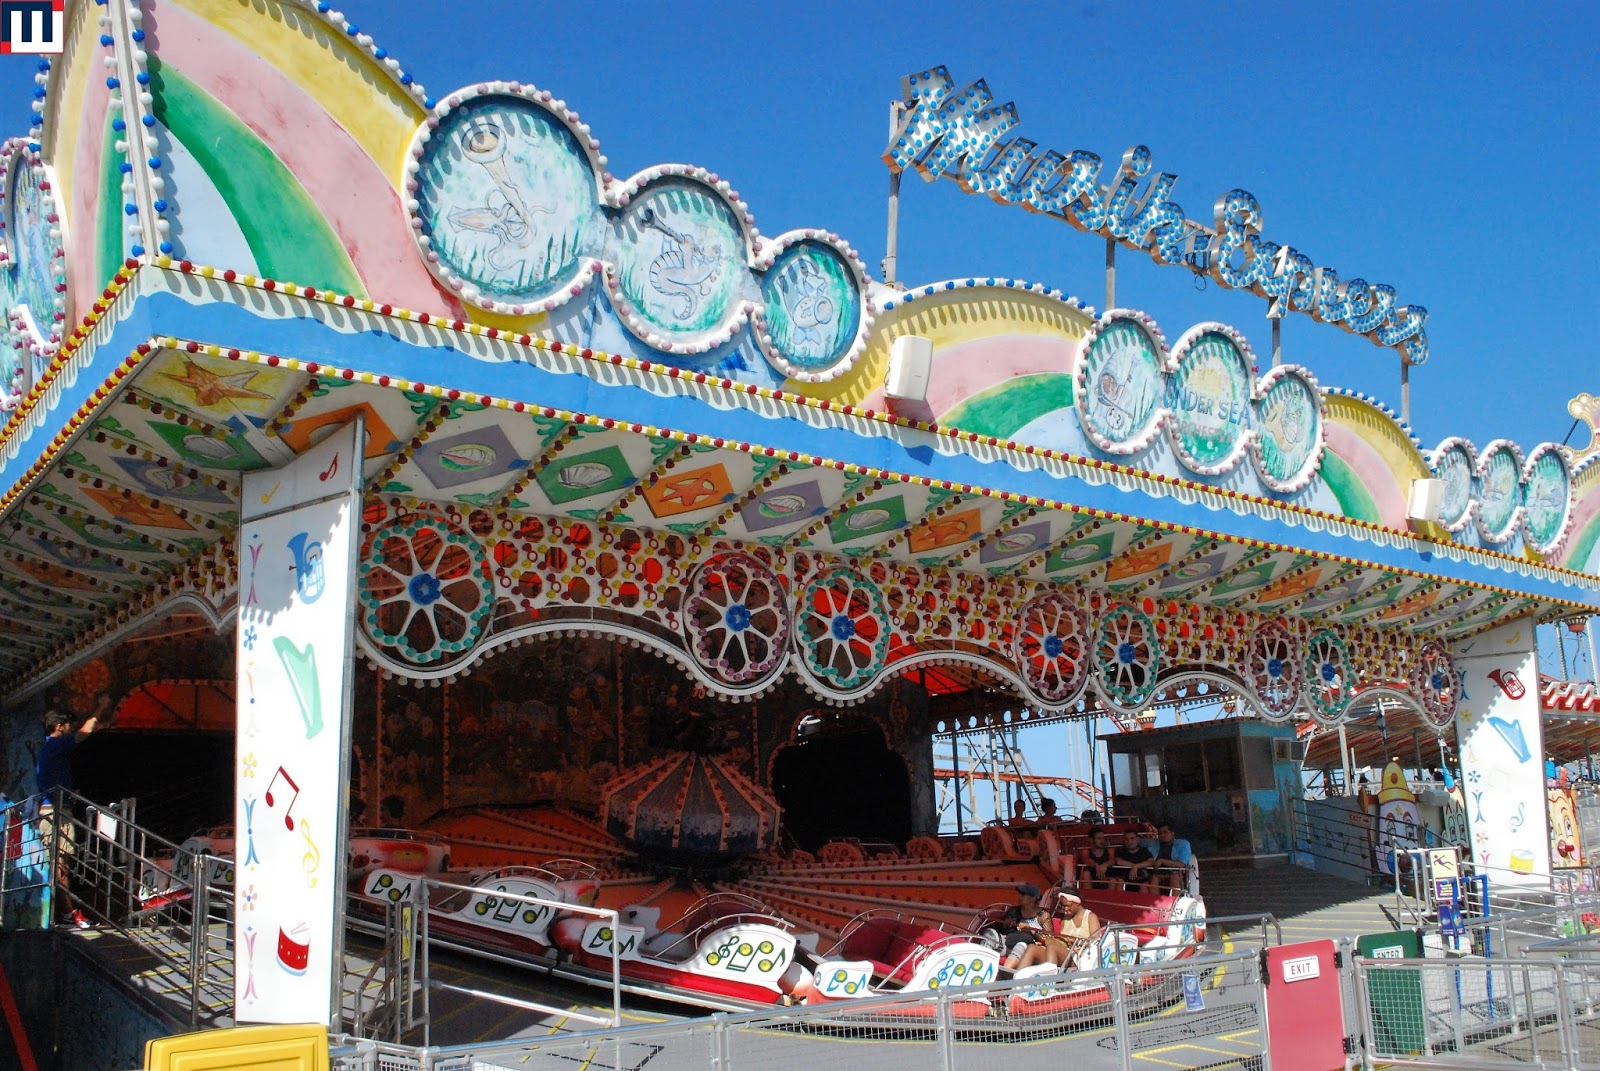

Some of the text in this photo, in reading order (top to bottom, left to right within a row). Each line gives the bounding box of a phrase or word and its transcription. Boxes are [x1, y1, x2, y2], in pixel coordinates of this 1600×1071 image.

[1163, 374, 1252, 430] UNDER SEA
[1376, 949, 1400, 960] ENTER
[1291, 962, 1311, 976] EXIT
